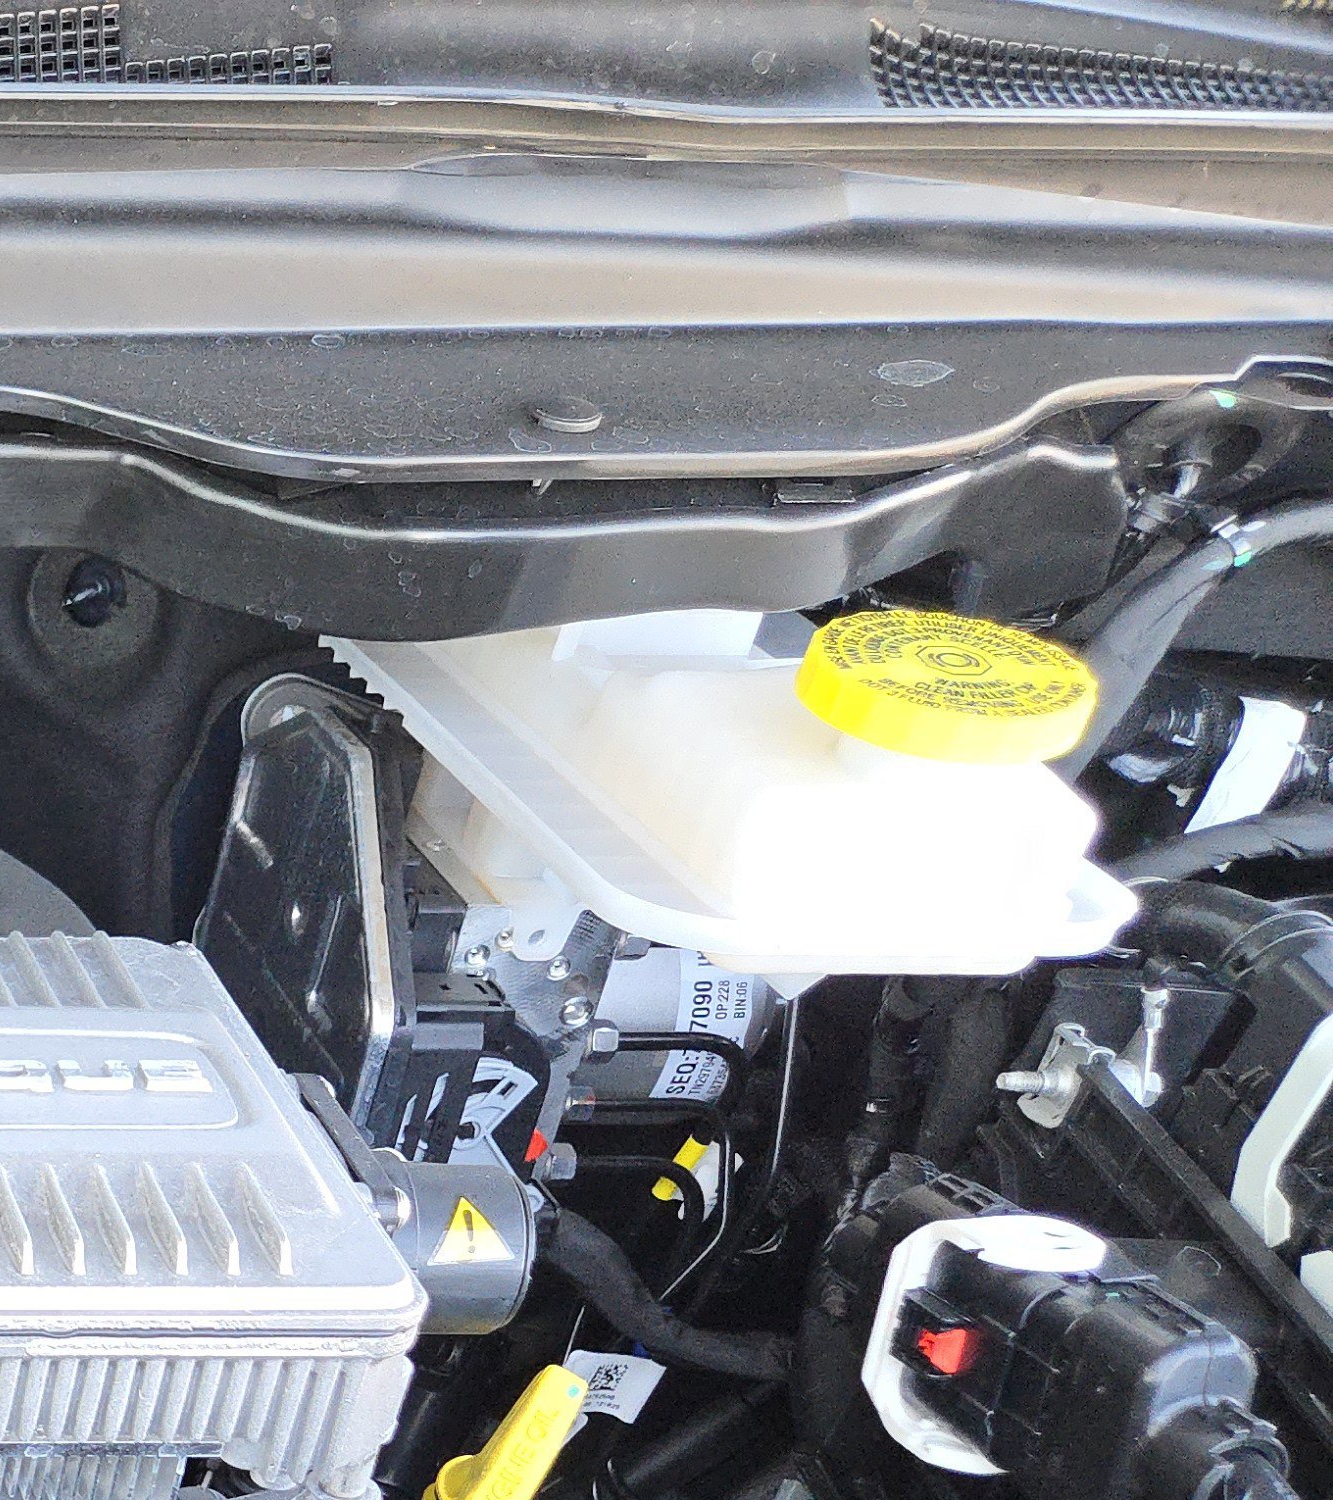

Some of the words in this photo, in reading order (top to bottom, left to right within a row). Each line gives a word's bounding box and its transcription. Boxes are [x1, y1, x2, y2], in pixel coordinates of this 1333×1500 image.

[878, 677, 935, 700] BEFORE
[914, 681, 965, 698] CLEAN
[970, 688, 1016, 700] FILLER
[734, 981, 748, 1019] BIN:06
[526, 1408, 560, 1443] OIL
